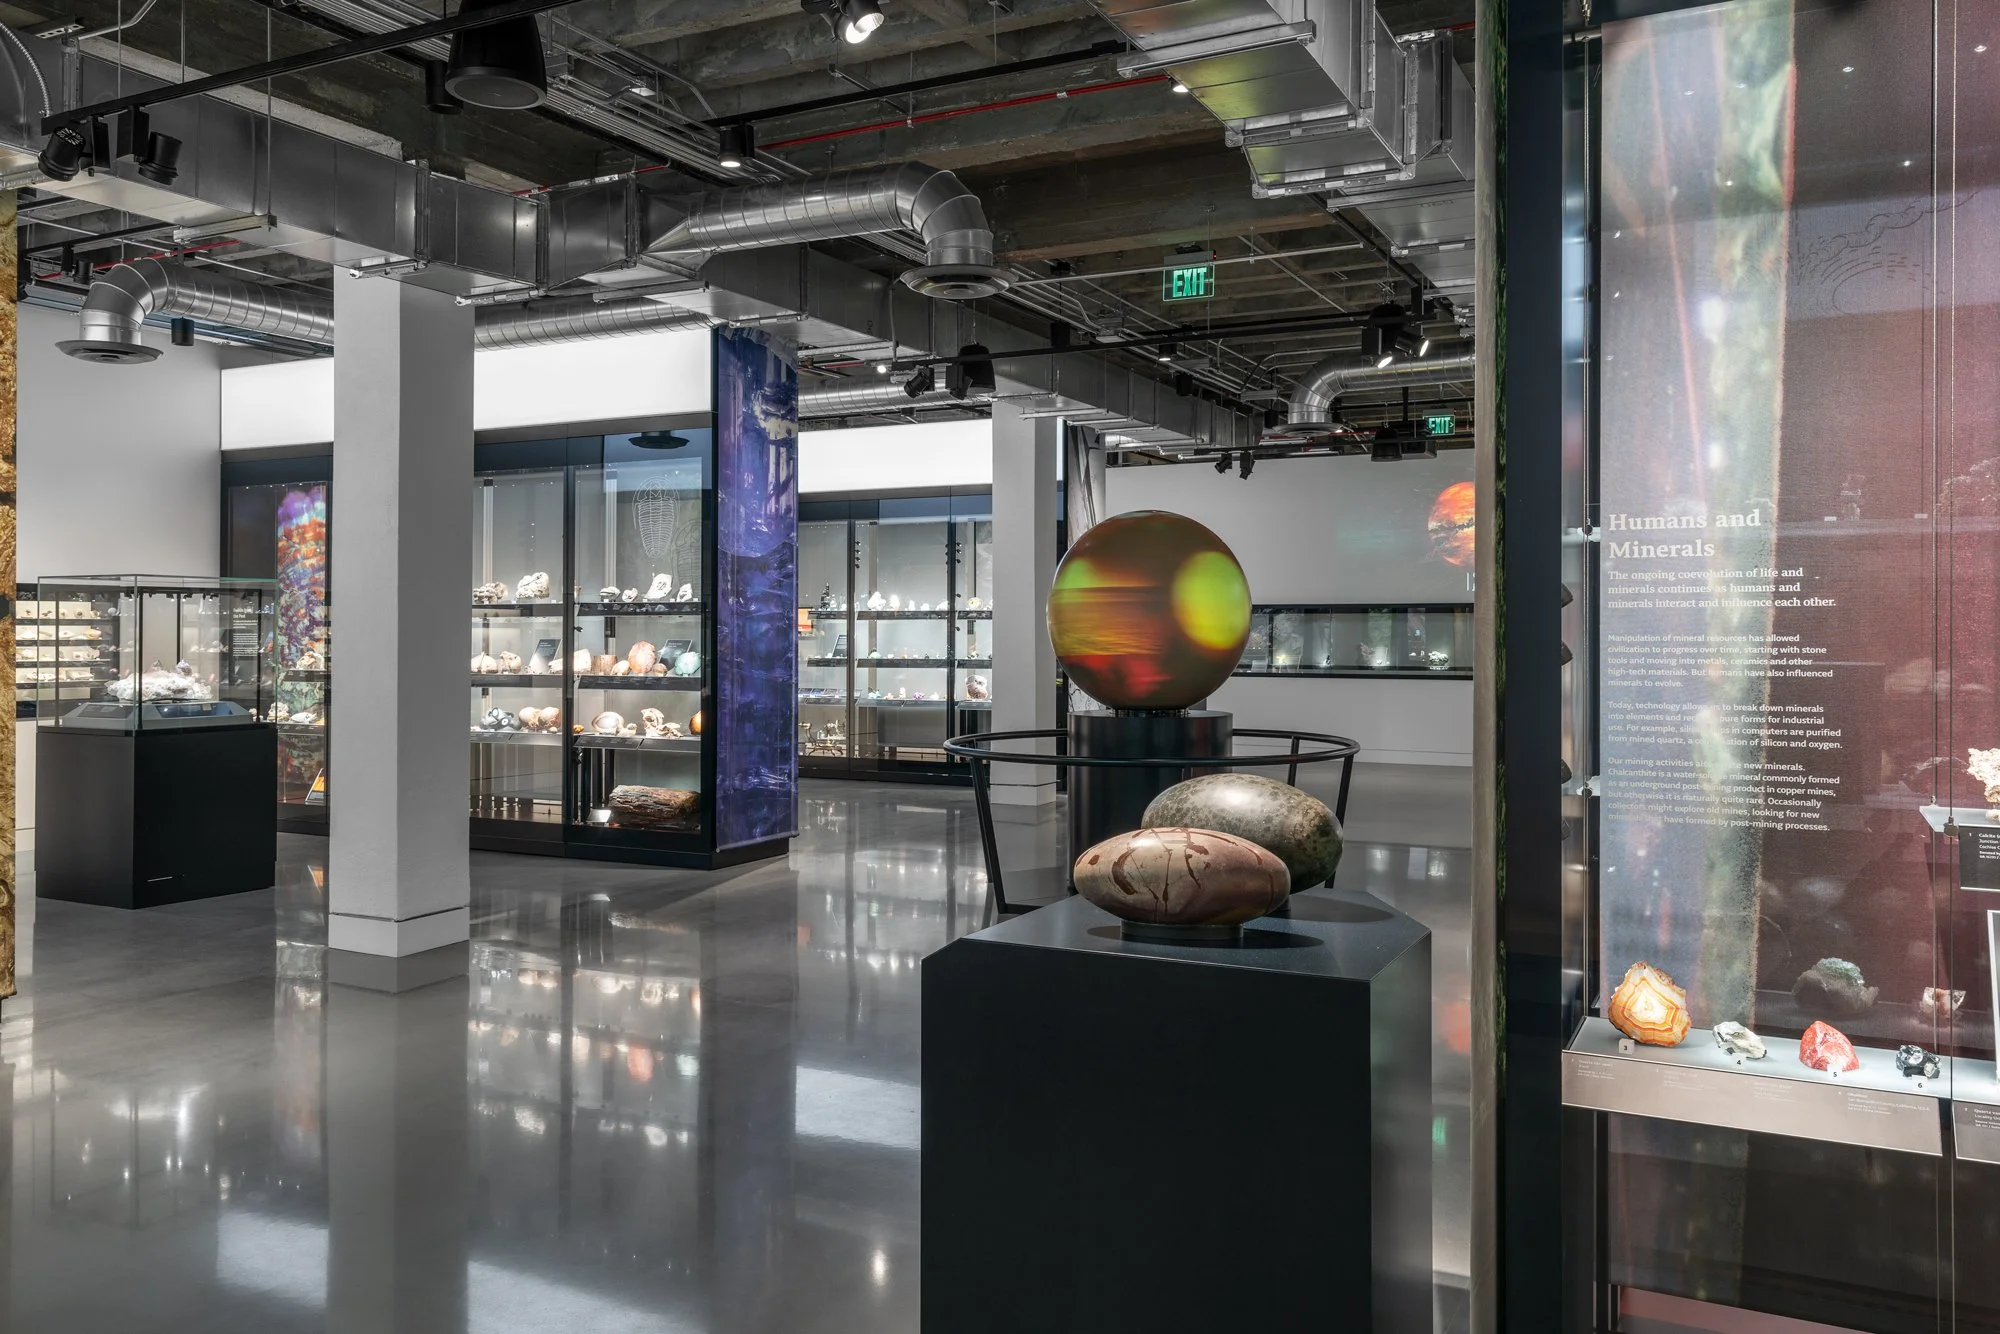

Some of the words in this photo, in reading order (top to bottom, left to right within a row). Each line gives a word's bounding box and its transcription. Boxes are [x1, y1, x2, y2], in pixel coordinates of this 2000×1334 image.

[1172, 267, 1208, 298] EXIT
[1428, 416, 1450, 434] EXIT
[1608, 514, 1708, 530] Humans
[1715, 509, 1761, 527] and
[1608, 539, 1714, 558] Minerals
[1608, 571, 1628, 579] The
[1631, 570, 1676, 581] ongoing
[1678, 569, 1742, 578] coevolution
[1746, 568, 1758, 577] of
[1760, 568, 1778, 577] life
[1781, 568, 1804, 576] and
[1608, 585, 1655, 593] minerals
[1658, 584, 1711, 593] continues
[1730, 584, 1775, 592] humans
[1779, 583, 1800, 591] and
[1608, 599, 1653, 608] minerals
[1656, 599, 1696, 607] interact
[1699, 599, 1718, 607] and
[1722, 598, 1772, 606] influence
[1775, 598, 1801, 606] each
[1803, 597, 1836, 606] other.
[1608, 634, 1660, 643] Manipulation
[1720, 646, 1741, 654] time,
[1745, 646, 1778, 655] starting
[1647, 658, 1677, 666] moving
[1698, 657, 1728, 665] metals,
[1608, 668, 1647, 676] high-tech
[1649, 668, 1688, 676] materials.
[1608, 701, 1634, 710] Today,
[1635, 702, 1680, 711] technology
[1759, 704, 1783, 712] down
[1741, 715, 1765, 723] forms
[1782, 716, 1824, 724] industrial
[1641, 725, 1678, 734] example,
[1742, 728, 1788, 736] computers
[1806, 729, 1841, 737] purified
[1629, 735, 1655, 743] mined
[1657, 736, 1685, 744] quartz,
[1760, 739, 1788, 747] silicon
[1808, 742, 1842, 750] oxygen.
[1625, 757, 1653, 767] mining
[1656, 758, 1693, 766] activities
[1764, 762, 1805, 771] minerals.
[1608, 768, 1656, 777] Chalcanthite
[1762, 775, 1806, 784] commonly
[1808, 776, 1840, 784] formed
[1630, 781, 1680, 790] underground
[1733, 785, 1765, 793] product
[1807, 788, 1836, 796] mines,
[1683, 795, 1719, 804] naturally
[1722, 796, 1744, 804] quite
[1768, 797, 1821, 809] Occasionally
[1648, 803, 1672, 813] might
[1674, 805, 1704, 813] explore
[1722, 807, 1750, 816] mines,
[1752, 808, 1784, 818] looking
[1786, 810, 1799, 818] for
[1664, 815, 1684, 823] have
[1686, 816, 1716, 825] formed
[1731, 820, 1783, 830] post-mining
[1785, 822, 1830, 831] processes.
